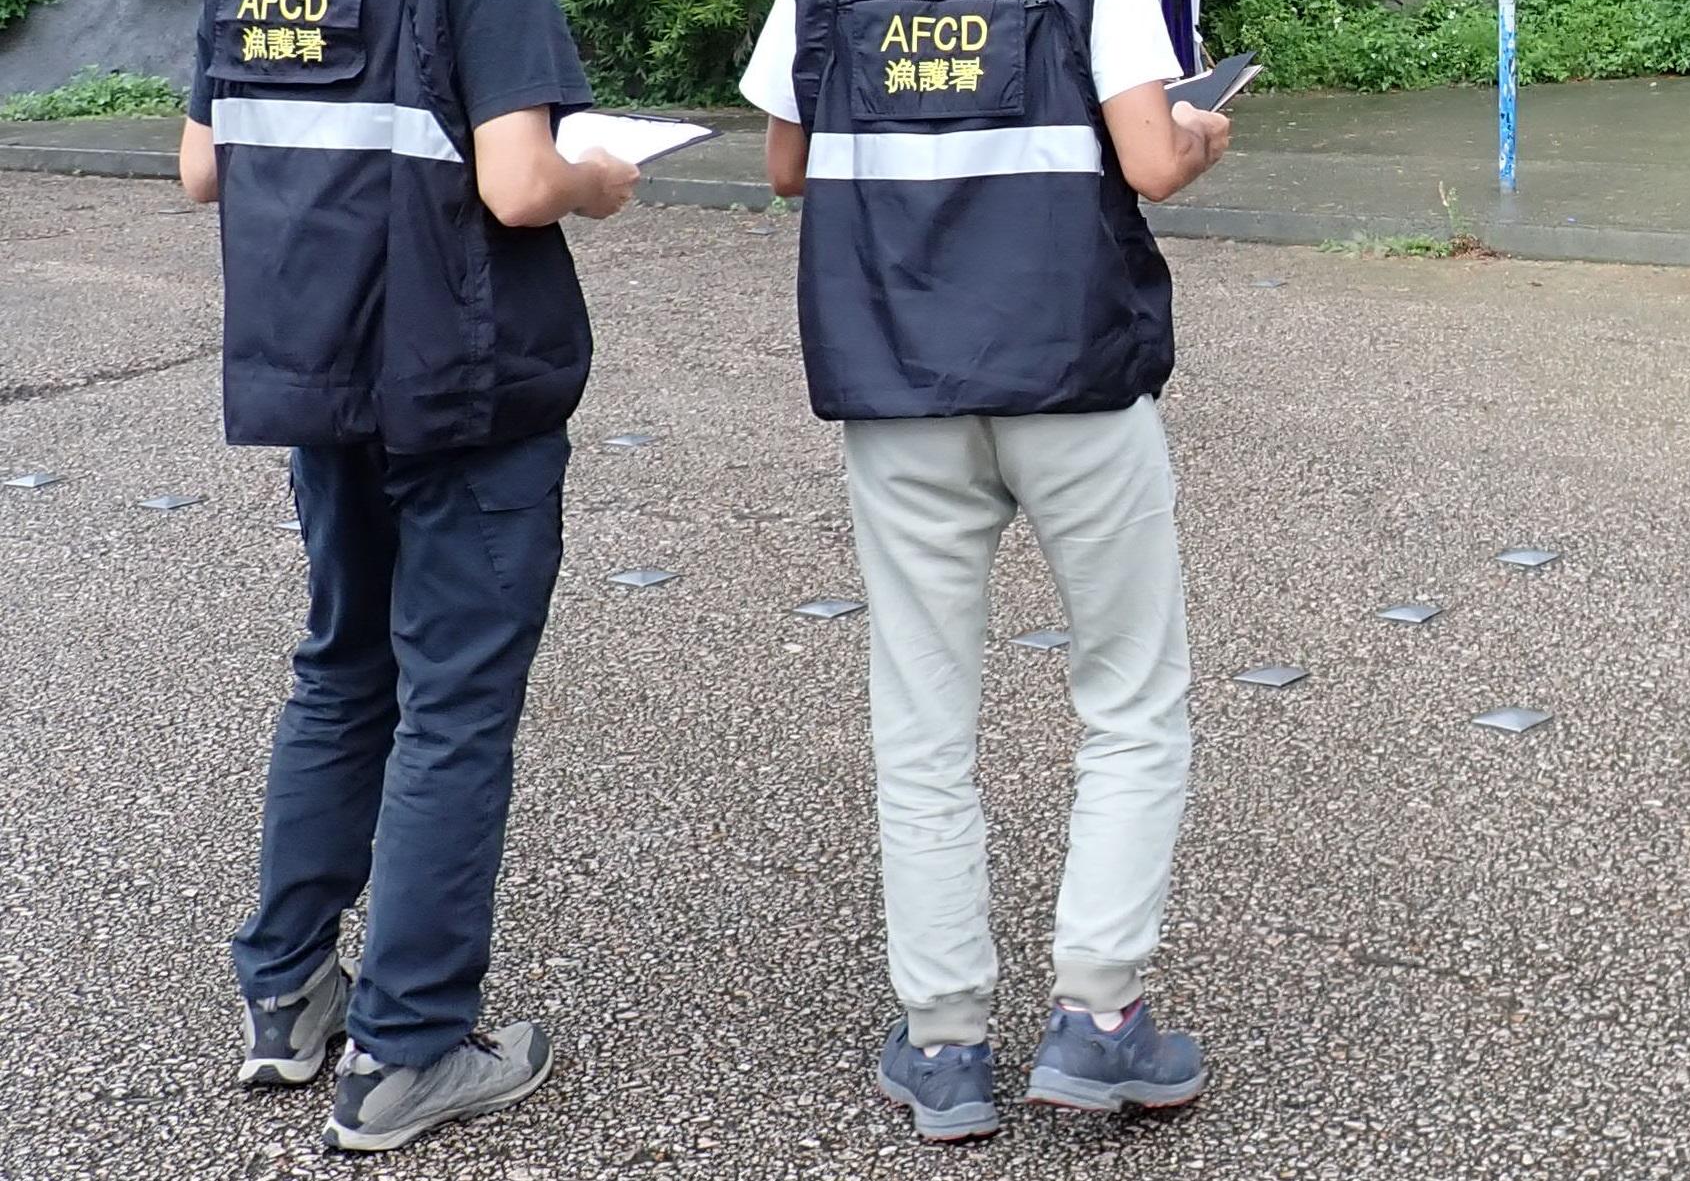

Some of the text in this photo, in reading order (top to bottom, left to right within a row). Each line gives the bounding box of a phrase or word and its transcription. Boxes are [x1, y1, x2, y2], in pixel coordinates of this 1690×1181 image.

[242, 26, 327, 63] 漁護署
[881, 15, 988, 53] AFCD
[884, 57, 984, 93] 漁護署
